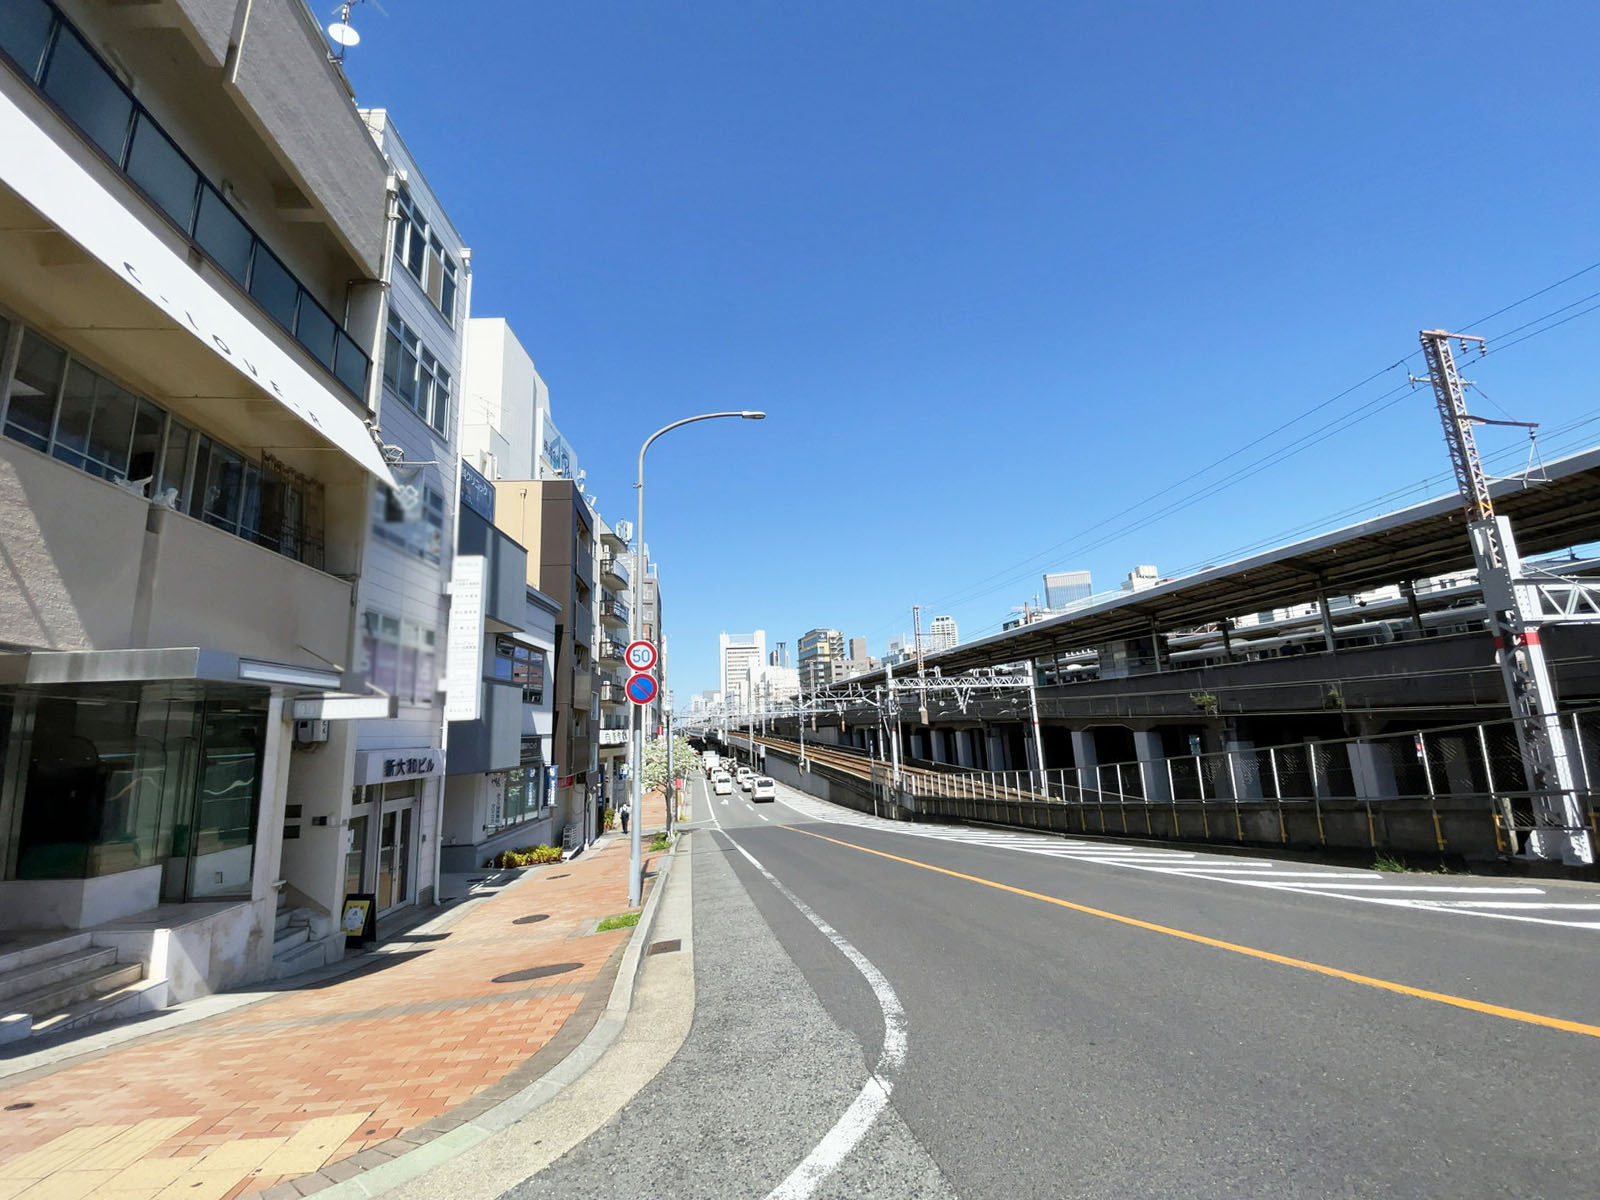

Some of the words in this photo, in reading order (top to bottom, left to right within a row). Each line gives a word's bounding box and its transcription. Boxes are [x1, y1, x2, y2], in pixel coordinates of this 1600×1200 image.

[632, 649, 650, 663] 50
[384, 757, 435, 777] 新大和ビル
